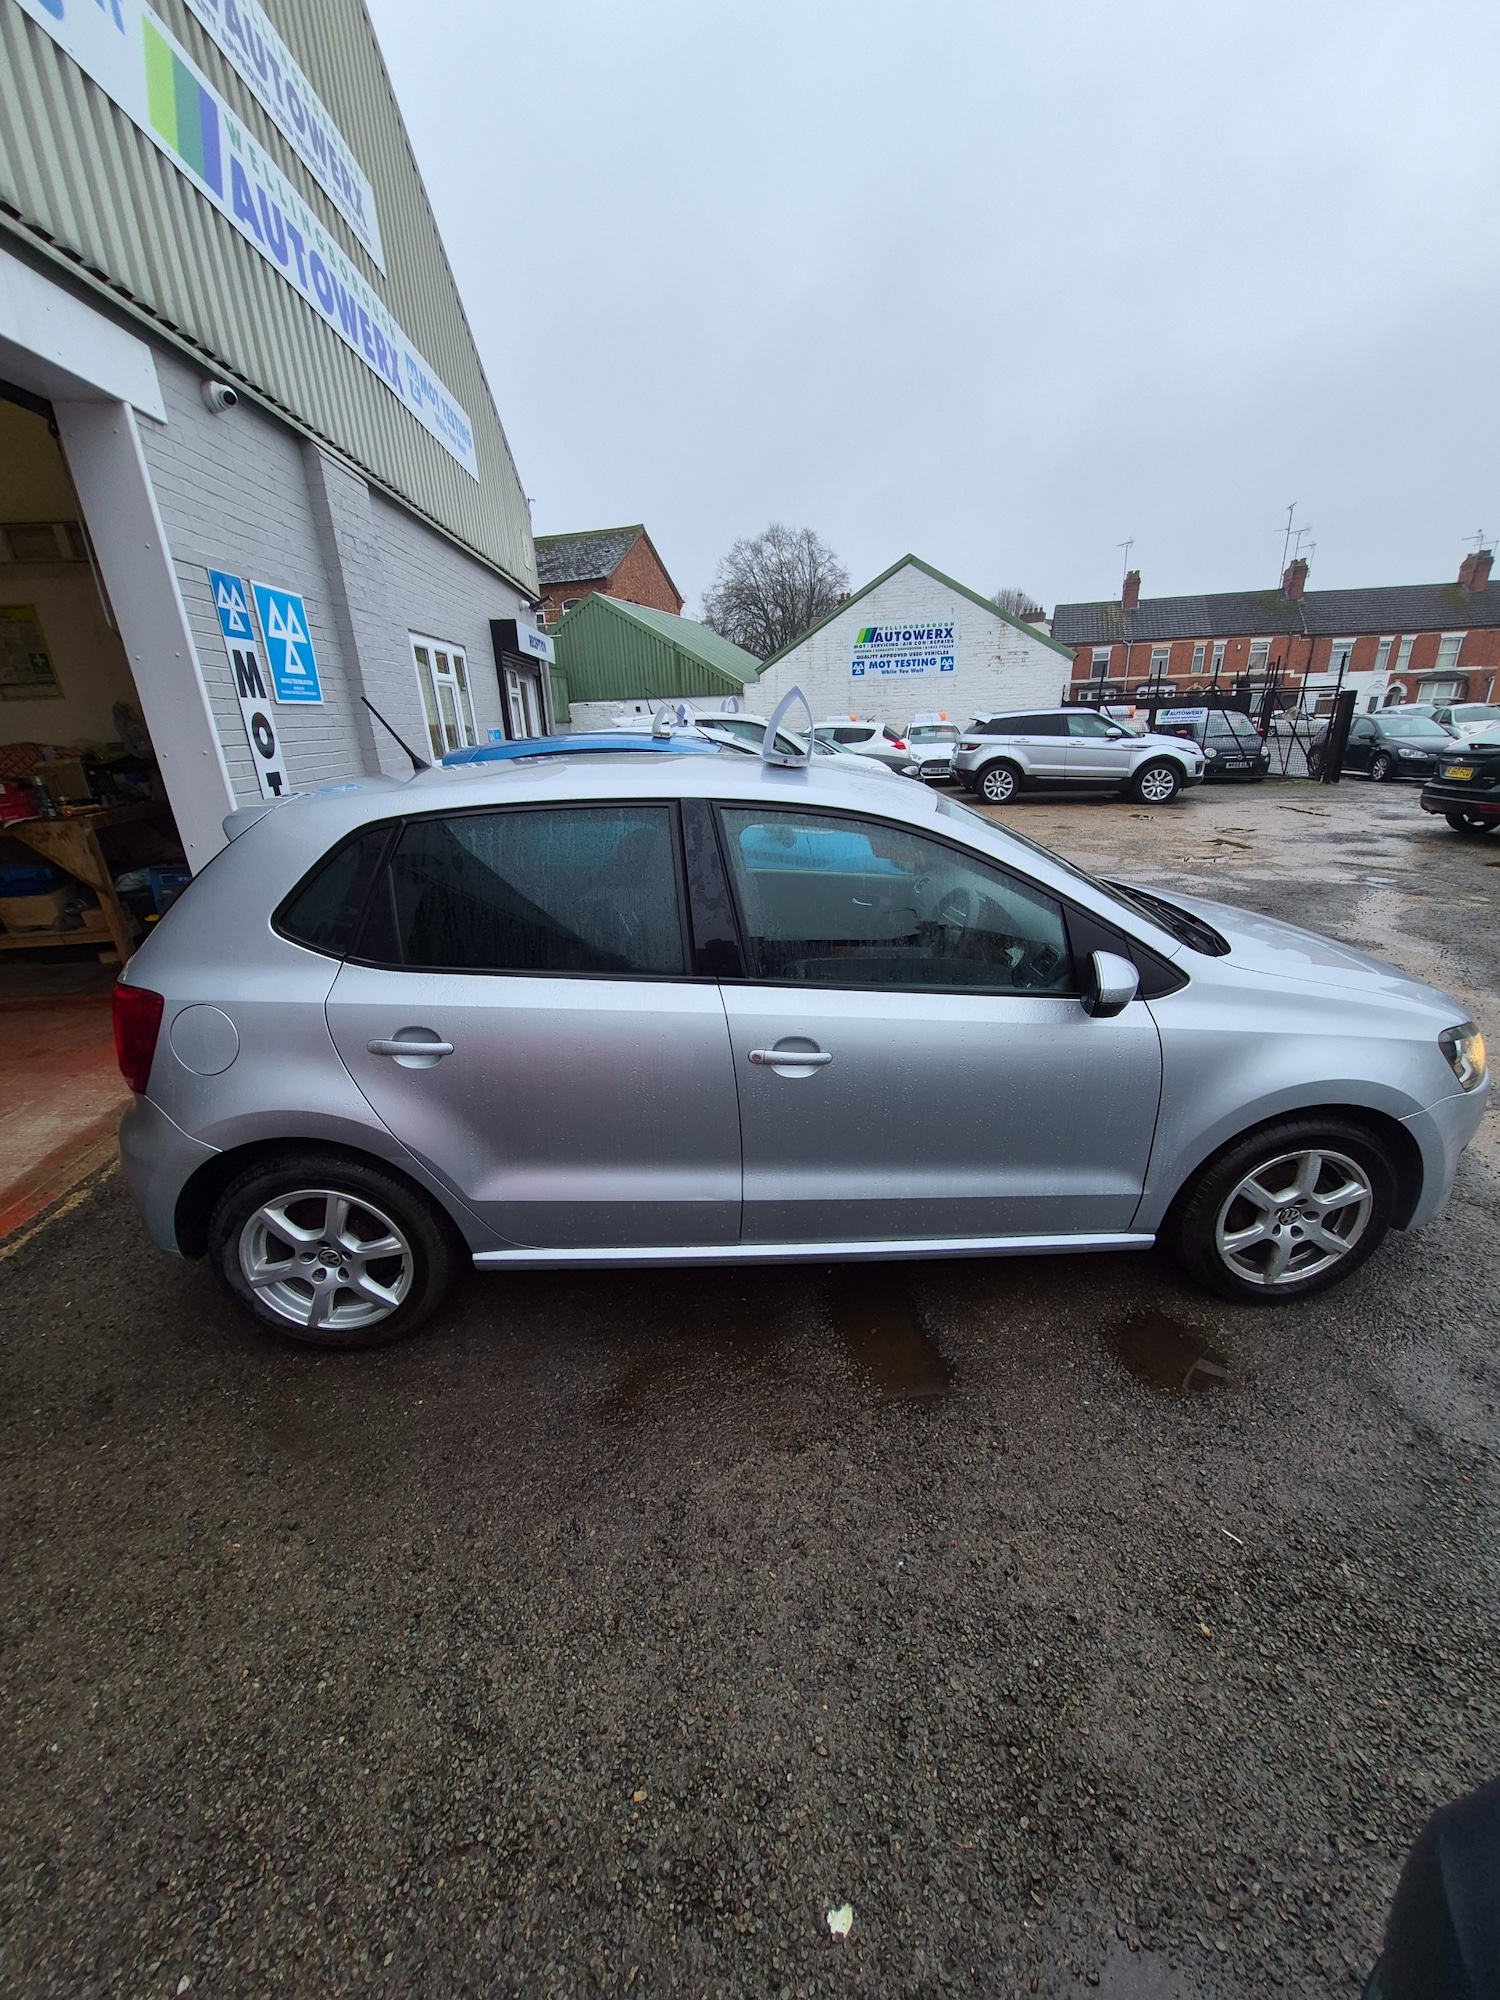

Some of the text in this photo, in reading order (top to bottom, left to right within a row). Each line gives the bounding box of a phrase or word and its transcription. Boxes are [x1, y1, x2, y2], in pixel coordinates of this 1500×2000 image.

[224, 0, 368, 231] AUTOWERX
[224, 115, 397, 342] WELLINGBOROUGH
[229, 152, 405, 398] AUTOWERX
[419, 370, 472, 449] MOT TESTING
[868, 658, 937, 669] MOT TESTING
[874, 627, 954, 643] AUTOWERX
[878, 621, 955, 631] WELLINGBOROUGH
